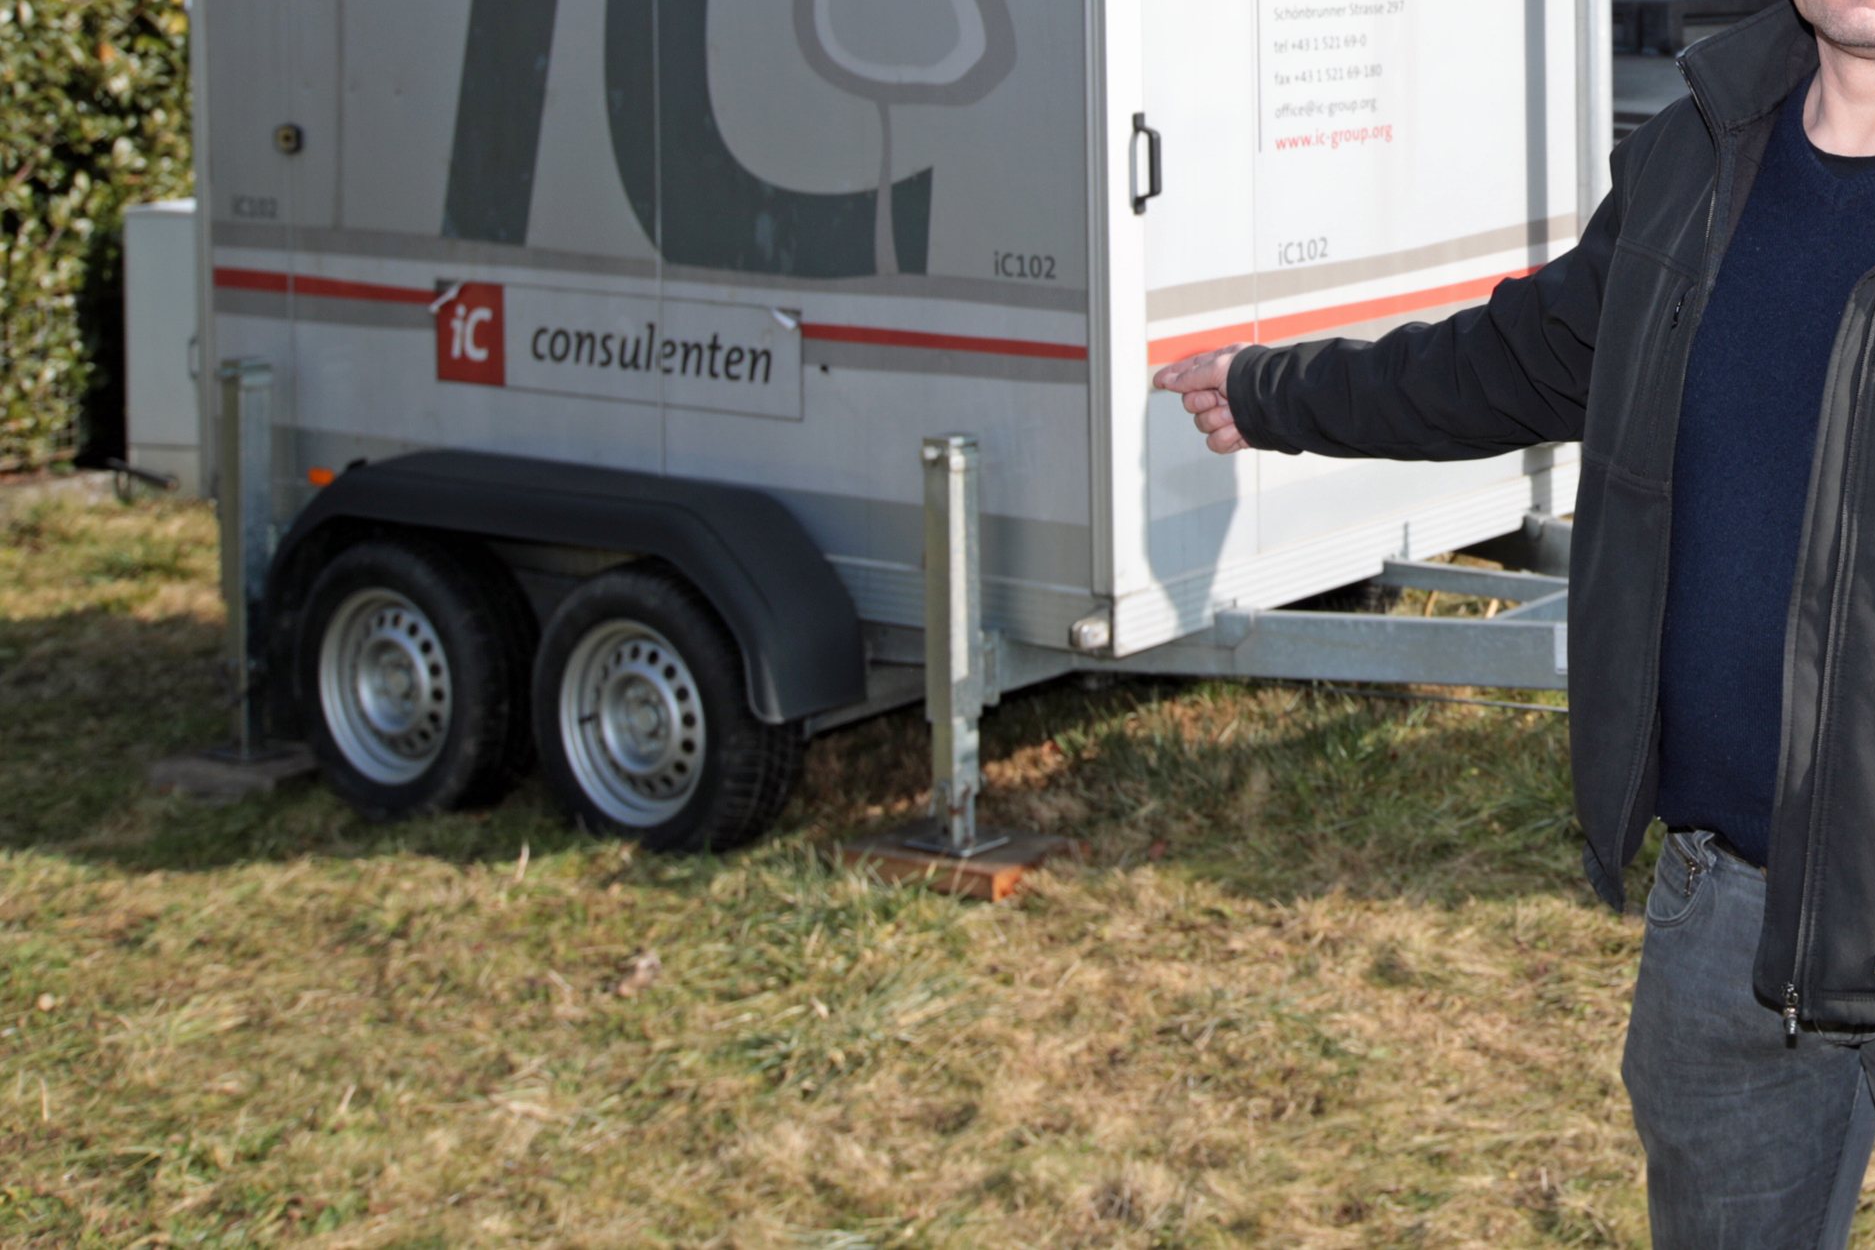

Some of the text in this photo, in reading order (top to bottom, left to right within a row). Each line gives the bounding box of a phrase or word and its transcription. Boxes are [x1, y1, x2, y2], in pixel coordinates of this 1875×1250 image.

[1274, 5, 1346, 22] Schönbrunner
[1349, 1, 1385, 17] Strasse
[1274, 40, 1288, 54] tel
[1274, 71, 1291, 86] fax
[1275, 98, 1378, 119] office@ic-group.org
[1275, 123, 1393, 151] www.ic-group.org
[1278, 236, 1329, 267] iC102
[993, 250, 1057, 280] iC102
[450, 303, 773, 384] iC consulenten
